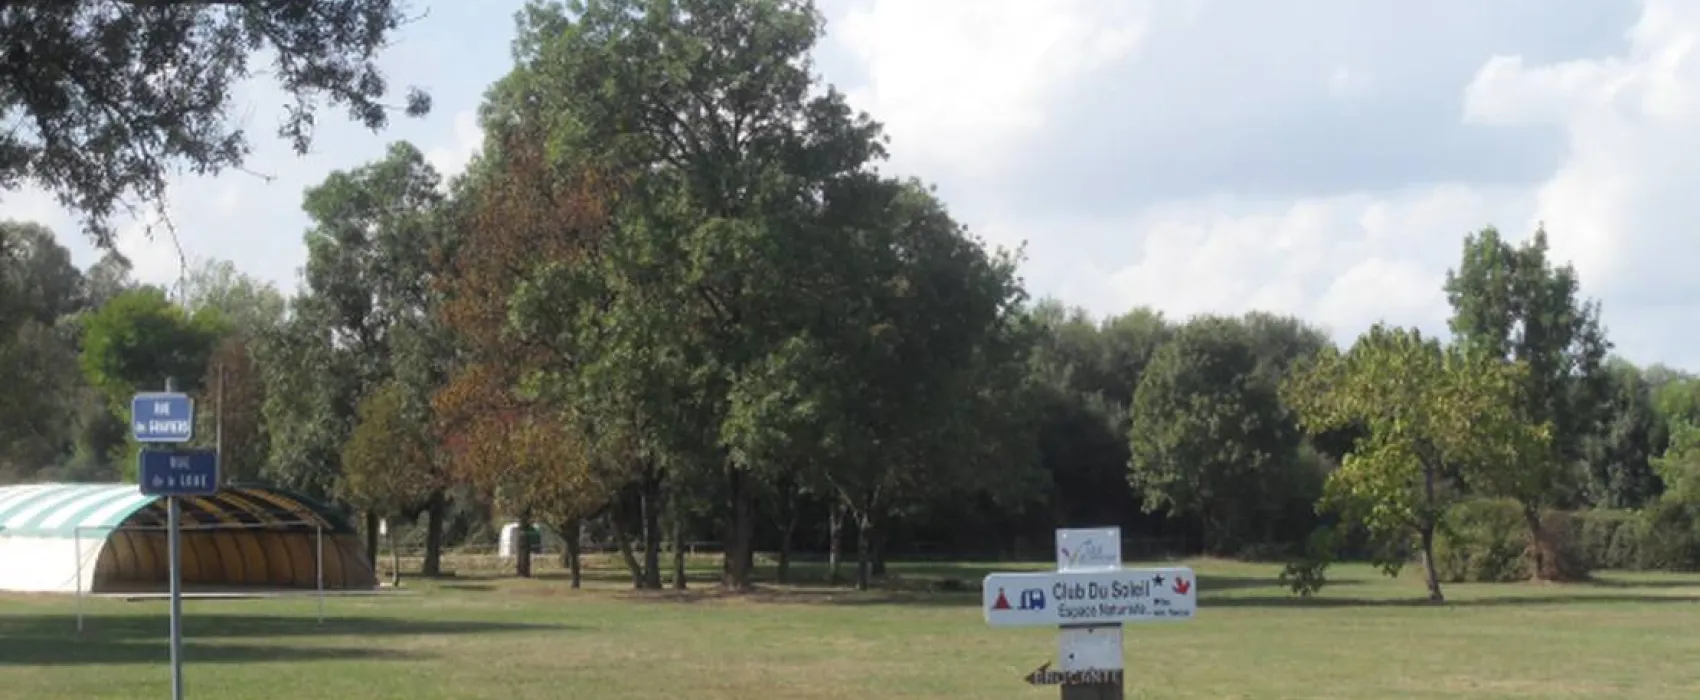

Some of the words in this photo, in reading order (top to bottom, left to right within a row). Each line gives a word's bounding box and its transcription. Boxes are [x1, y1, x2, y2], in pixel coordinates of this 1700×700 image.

[1053, 582, 1085, 600] Club
[1088, 582, 1108, 599] Du
[1111, 579, 1150, 598] Soleil
